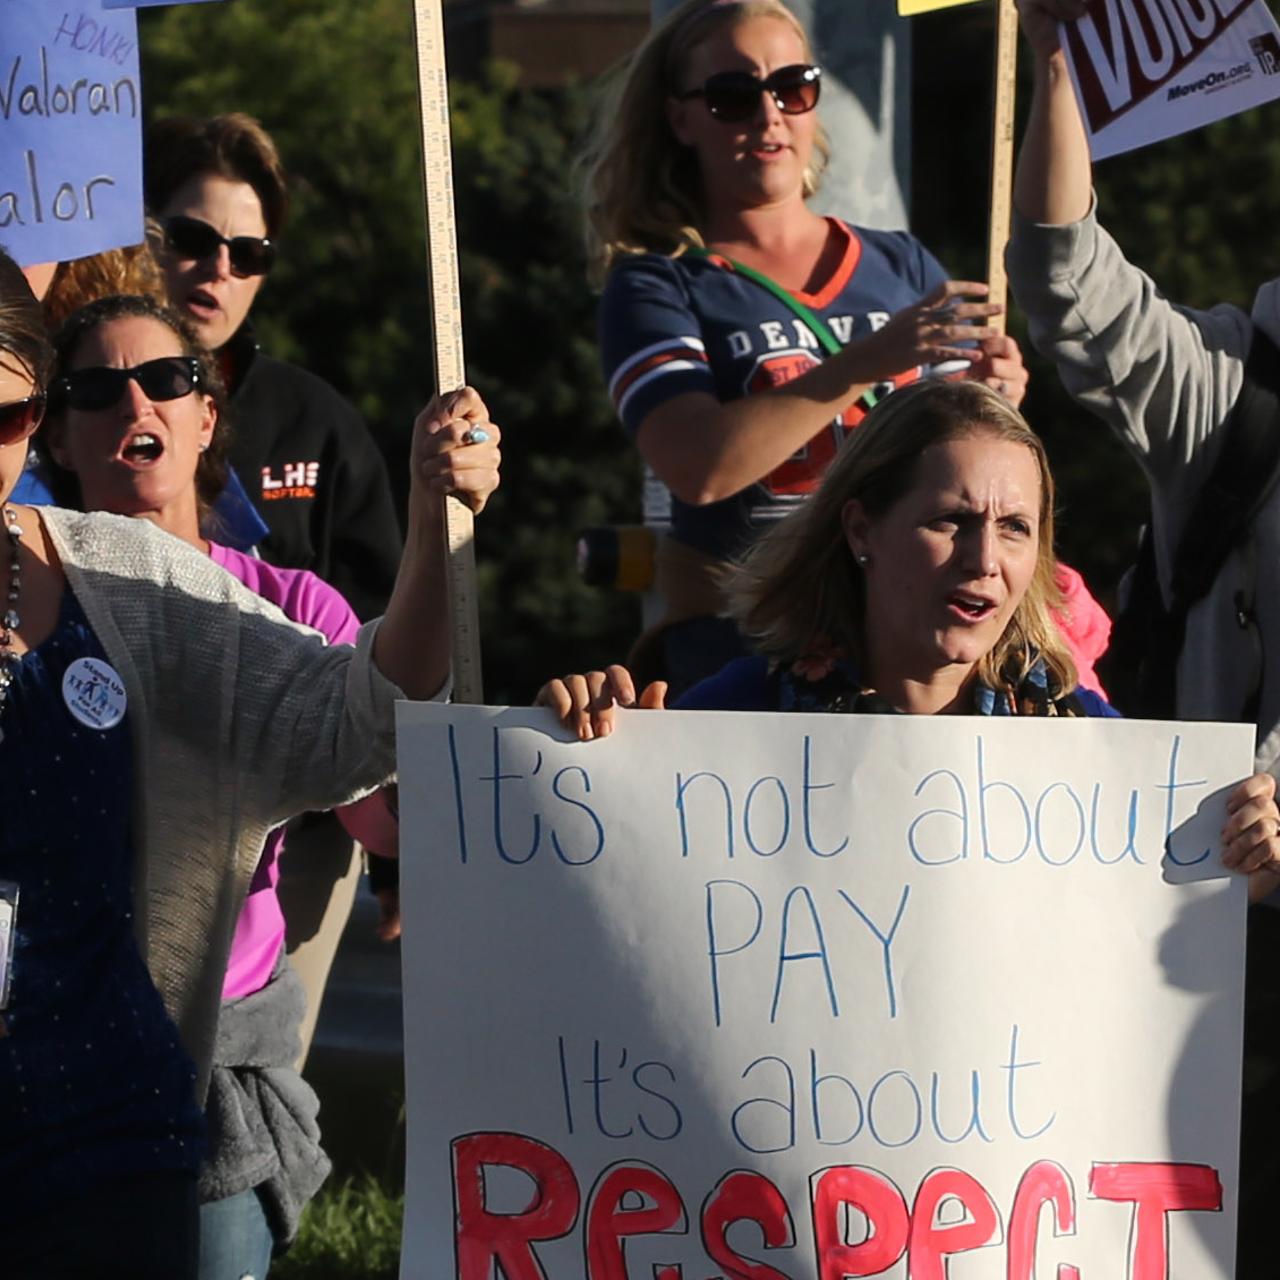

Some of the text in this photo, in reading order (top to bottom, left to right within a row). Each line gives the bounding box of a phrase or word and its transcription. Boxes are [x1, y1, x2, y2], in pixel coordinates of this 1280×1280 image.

[447, 722, 1216, 868] It's not about
[703, 877, 912, 1028] PAY
[556, 1022, 1058, 1155] It's about
